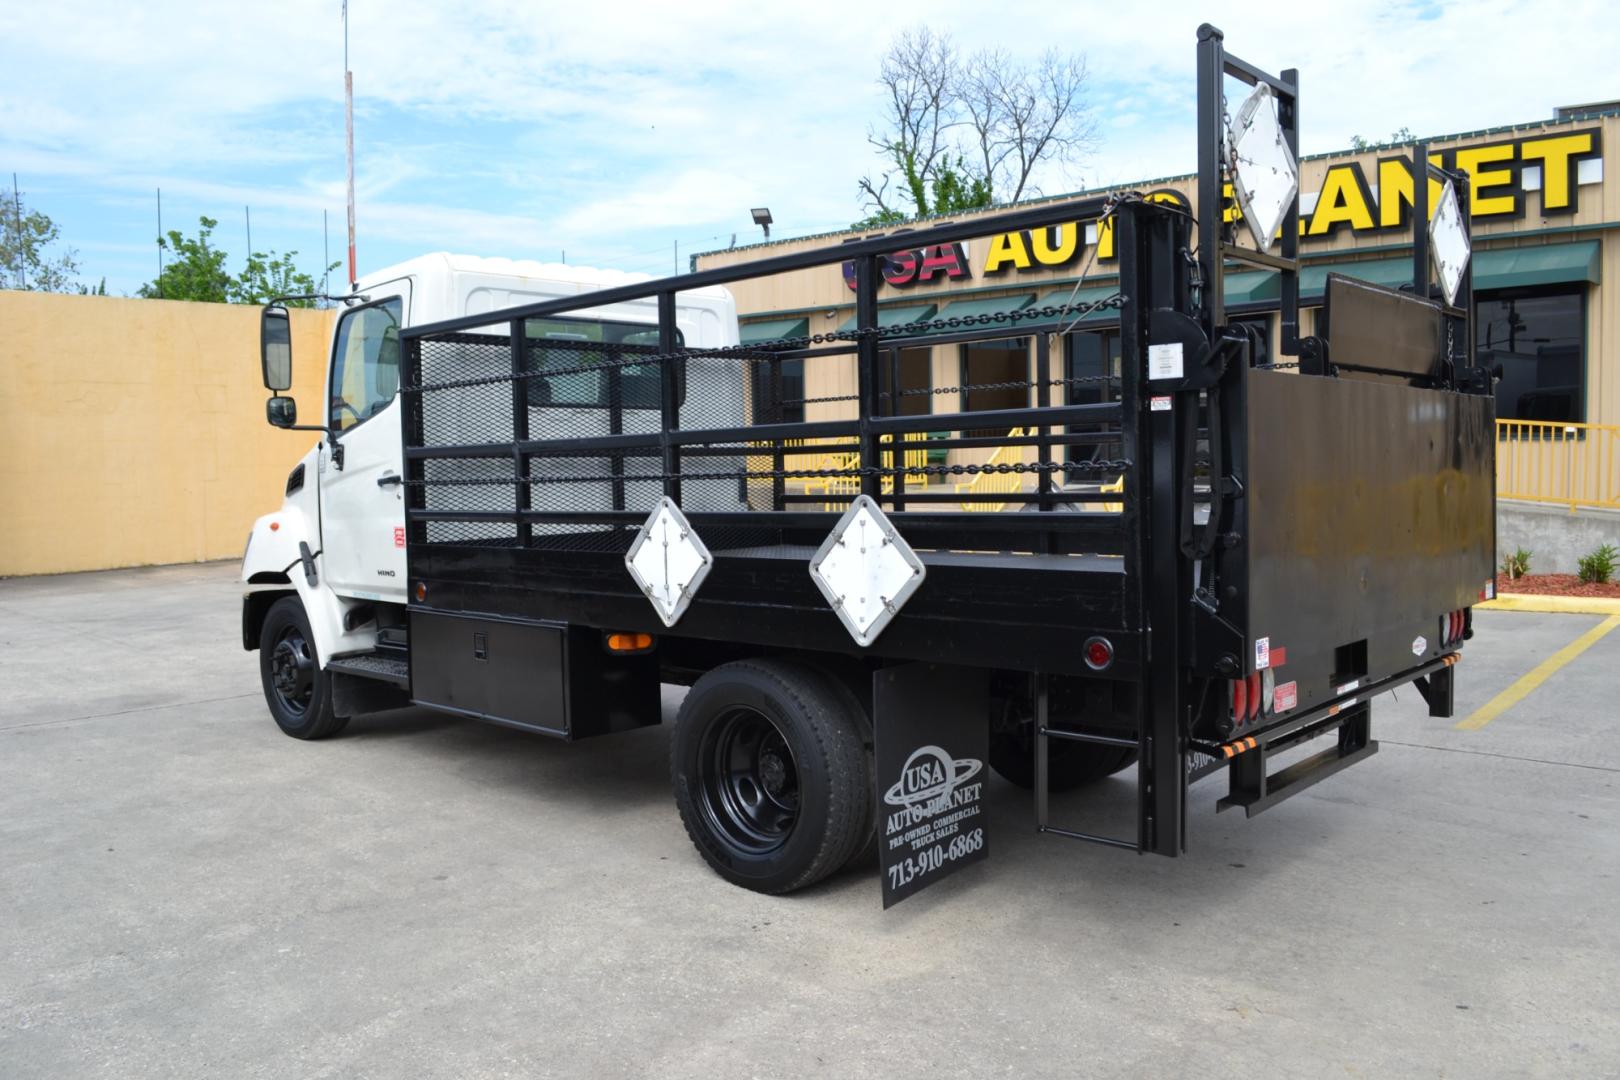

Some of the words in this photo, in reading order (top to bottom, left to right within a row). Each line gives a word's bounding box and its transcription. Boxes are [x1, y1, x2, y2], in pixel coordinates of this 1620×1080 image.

[377, 569, 395, 577] HINO
[906, 760, 944, 793] USA
[886, 804, 923, 836] AUTO
[926, 782, 982, 818] PLANET
[889, 824, 931, 850] PRE-OWNED
[933, 805, 980, 830] COMMERCIAL
[911, 831, 936, 850] TRUCK
[935, 823, 959, 841] SALES
[888, 828, 983, 890] 713-910-6868
